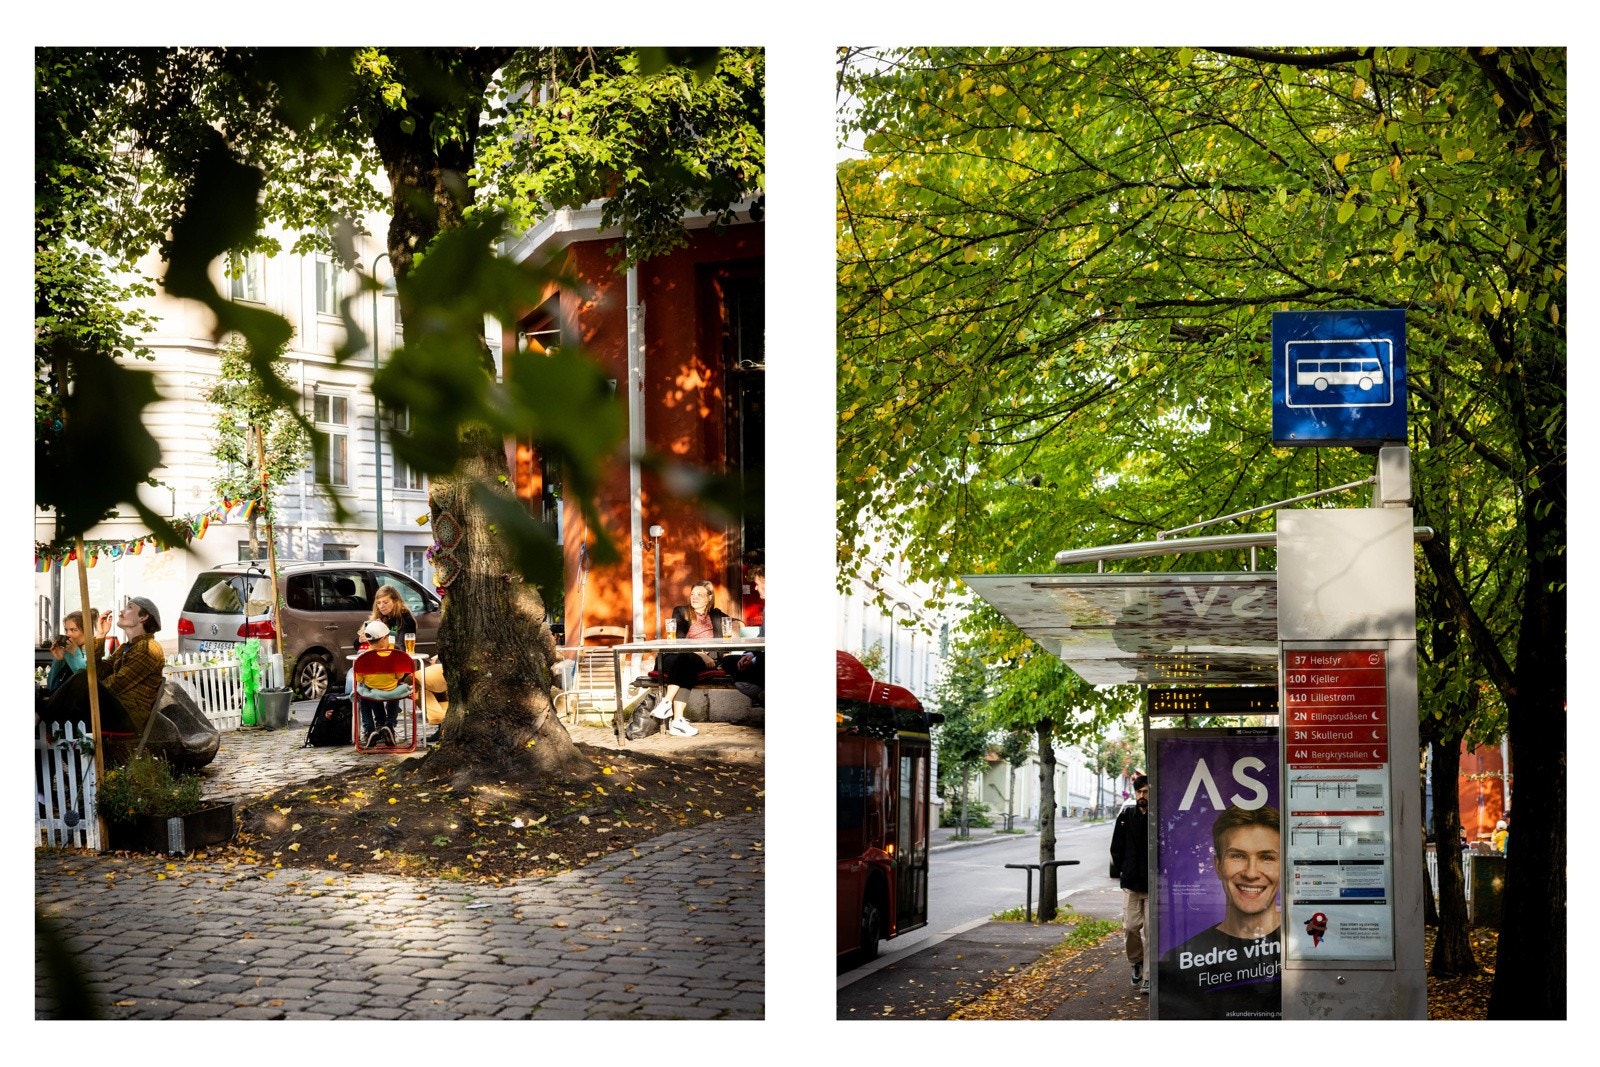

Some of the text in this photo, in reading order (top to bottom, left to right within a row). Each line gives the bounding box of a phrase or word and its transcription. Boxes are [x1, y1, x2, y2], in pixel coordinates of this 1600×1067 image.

[1294, 656, 1342, 667] 37 Helsfyr
[1289, 675, 1340, 685] 100 Kjeller
[1289, 693, 1355, 702] 110 Lillestrøm
[1294, 712, 1368, 722] 2N Ellingsrudåsen
[1294, 731, 1353, 740] 3N Skullerud
[1294, 750, 1368, 760] 4N Bergkrystallen
[1179, 946, 1238, 970] Bedre
[1198, 971, 1233, 987] Flere
